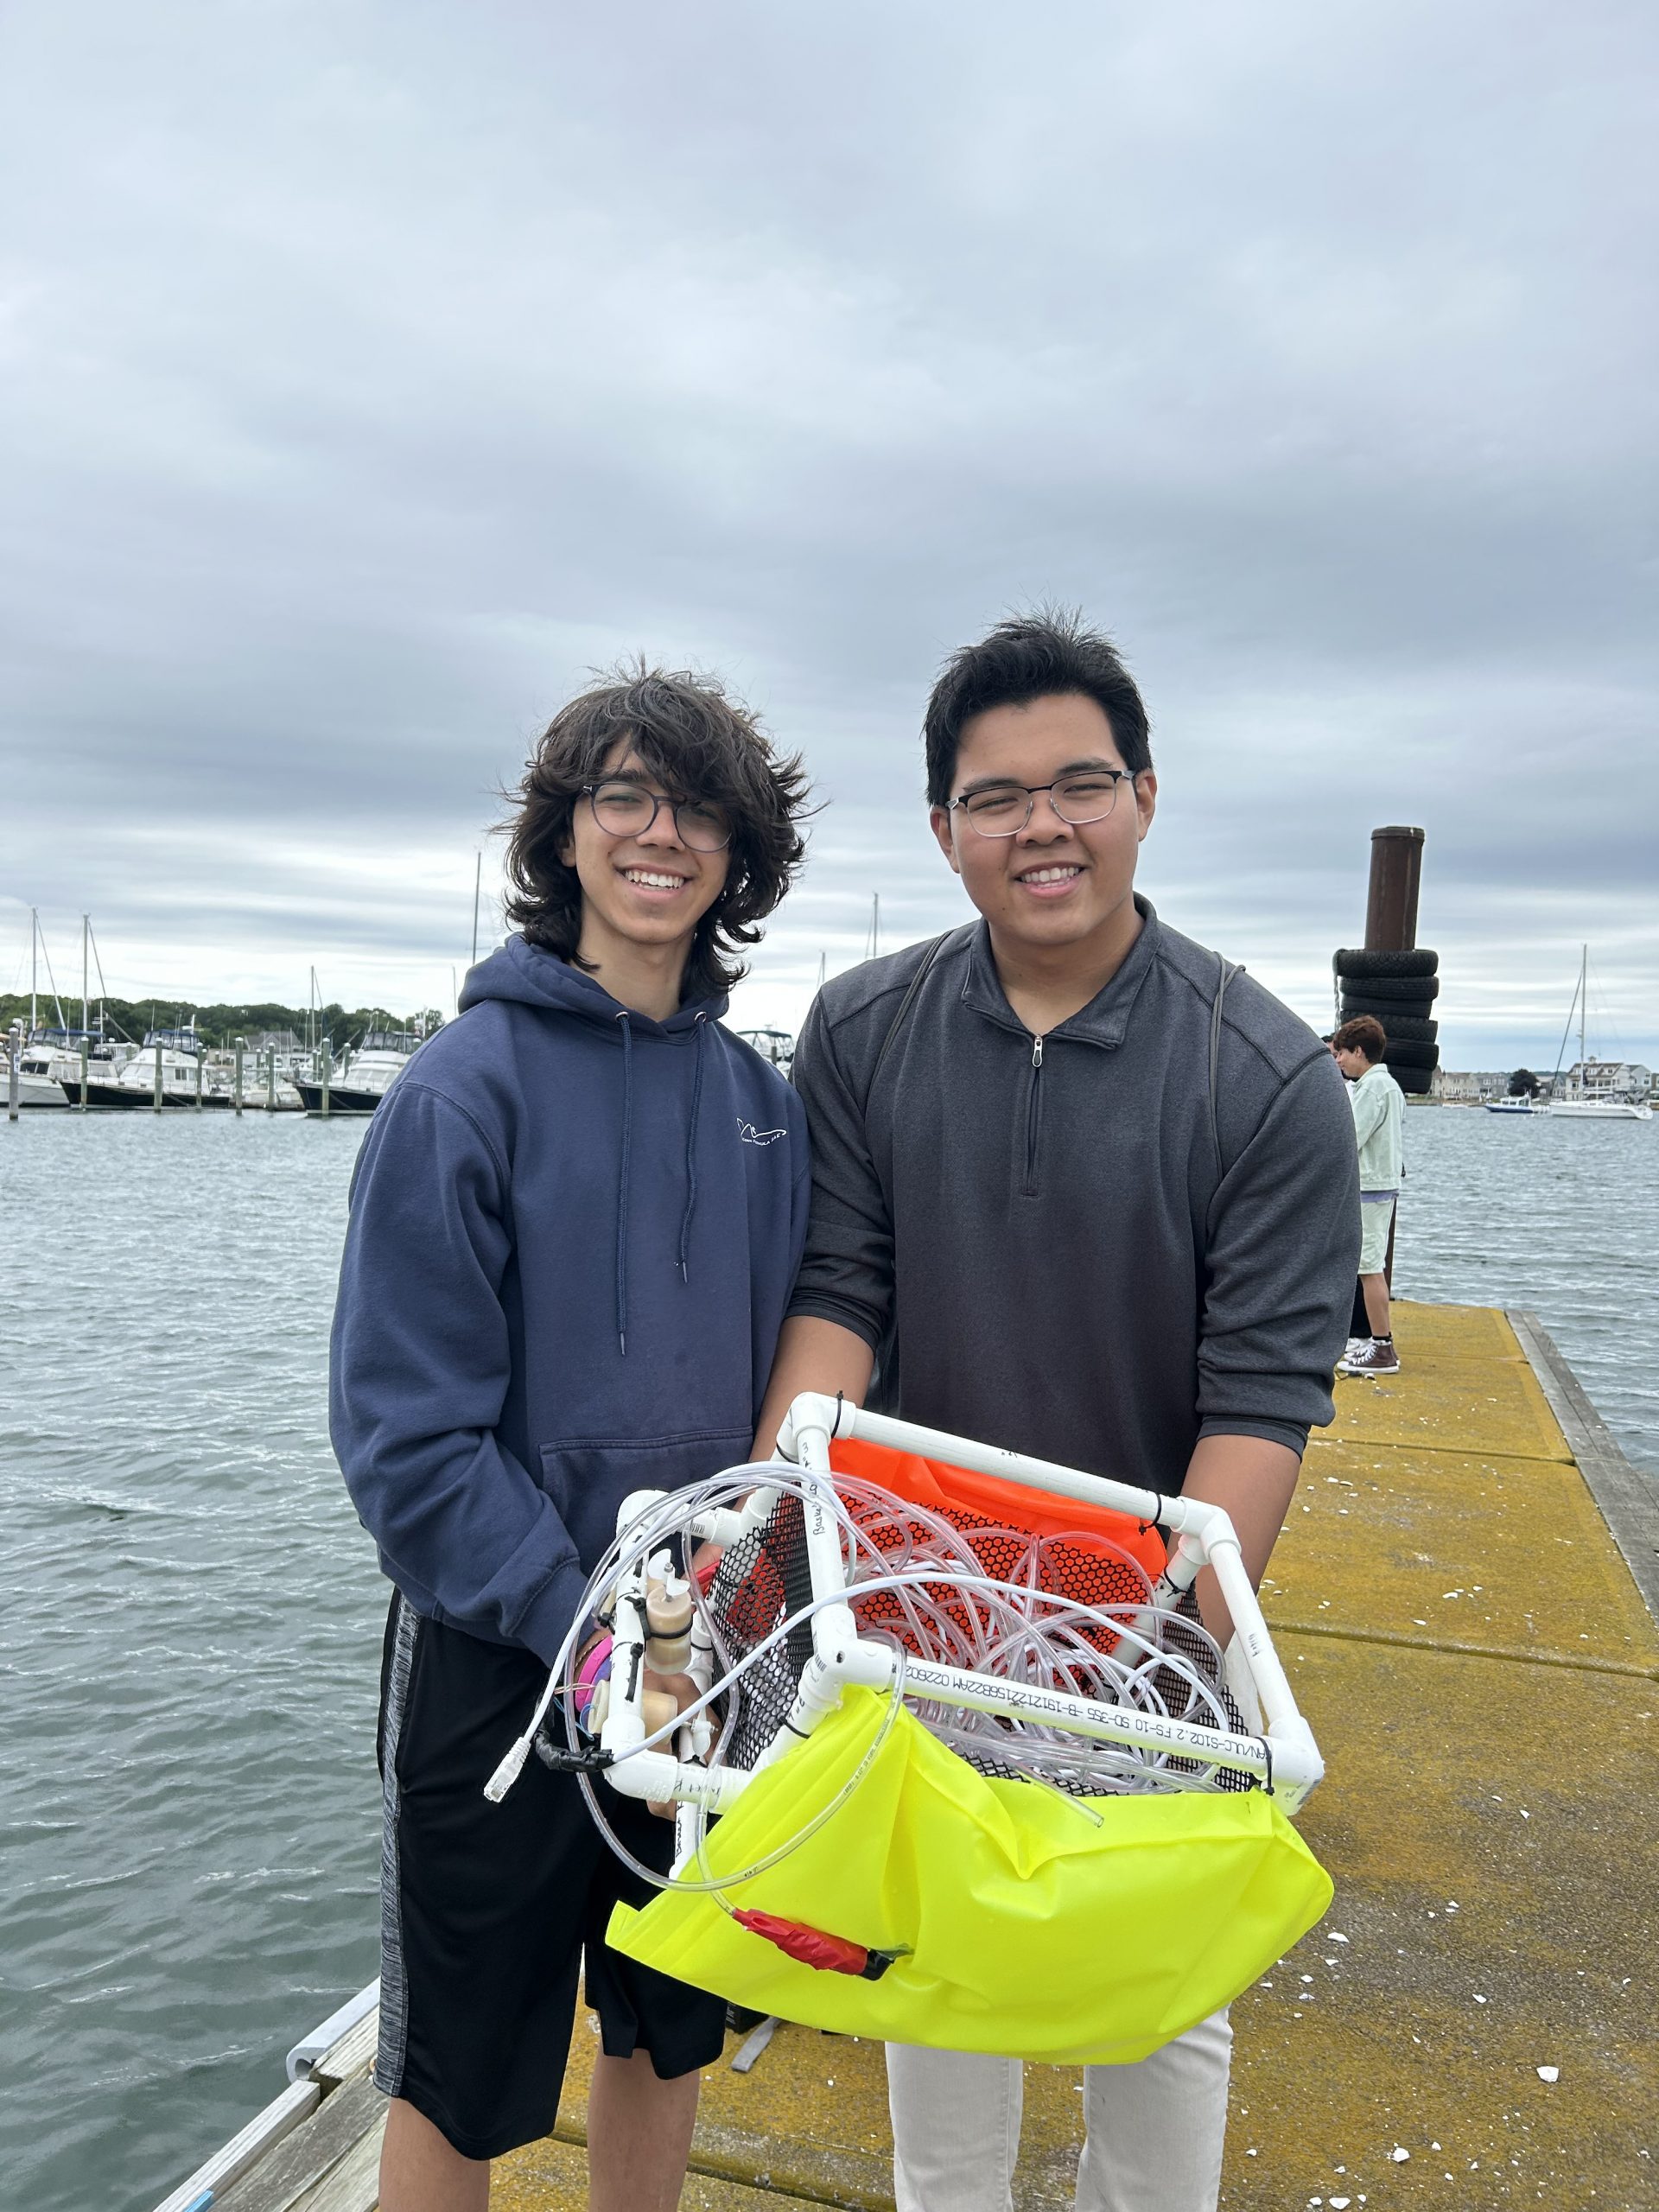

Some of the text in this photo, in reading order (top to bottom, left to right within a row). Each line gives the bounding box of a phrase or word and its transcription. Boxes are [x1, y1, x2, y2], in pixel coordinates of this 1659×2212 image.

[1087, 1707, 1130, 1729] SD-355
[1135, 1719, 1171, 1738] FS-10
[1176, 1728, 1268, 1759] AN/ULC-S102.2
